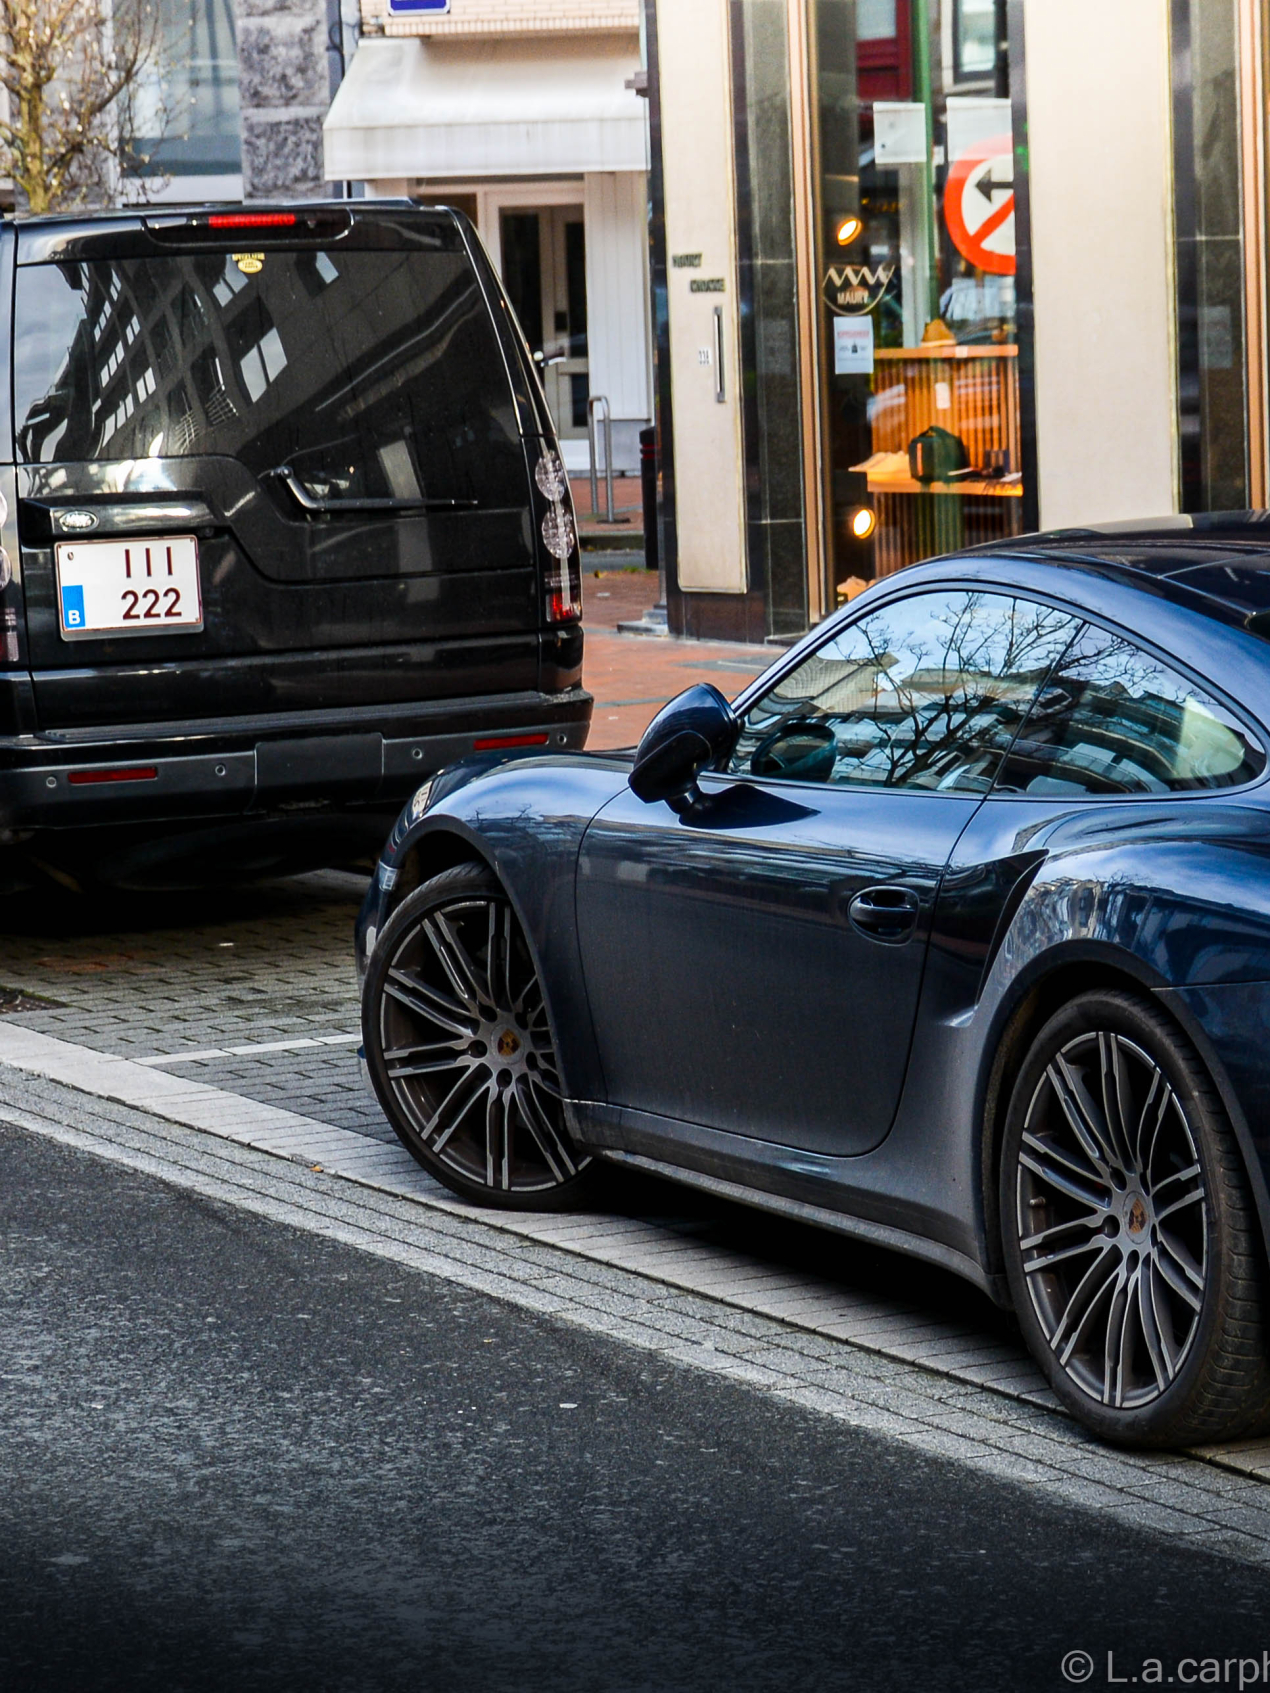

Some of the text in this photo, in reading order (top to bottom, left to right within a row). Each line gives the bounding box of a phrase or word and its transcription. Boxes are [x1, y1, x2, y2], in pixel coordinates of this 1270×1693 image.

[837, 289, 870, 305] MAURY
[121, 587, 182, 620] 222
[68, 610, 81, 625] B
